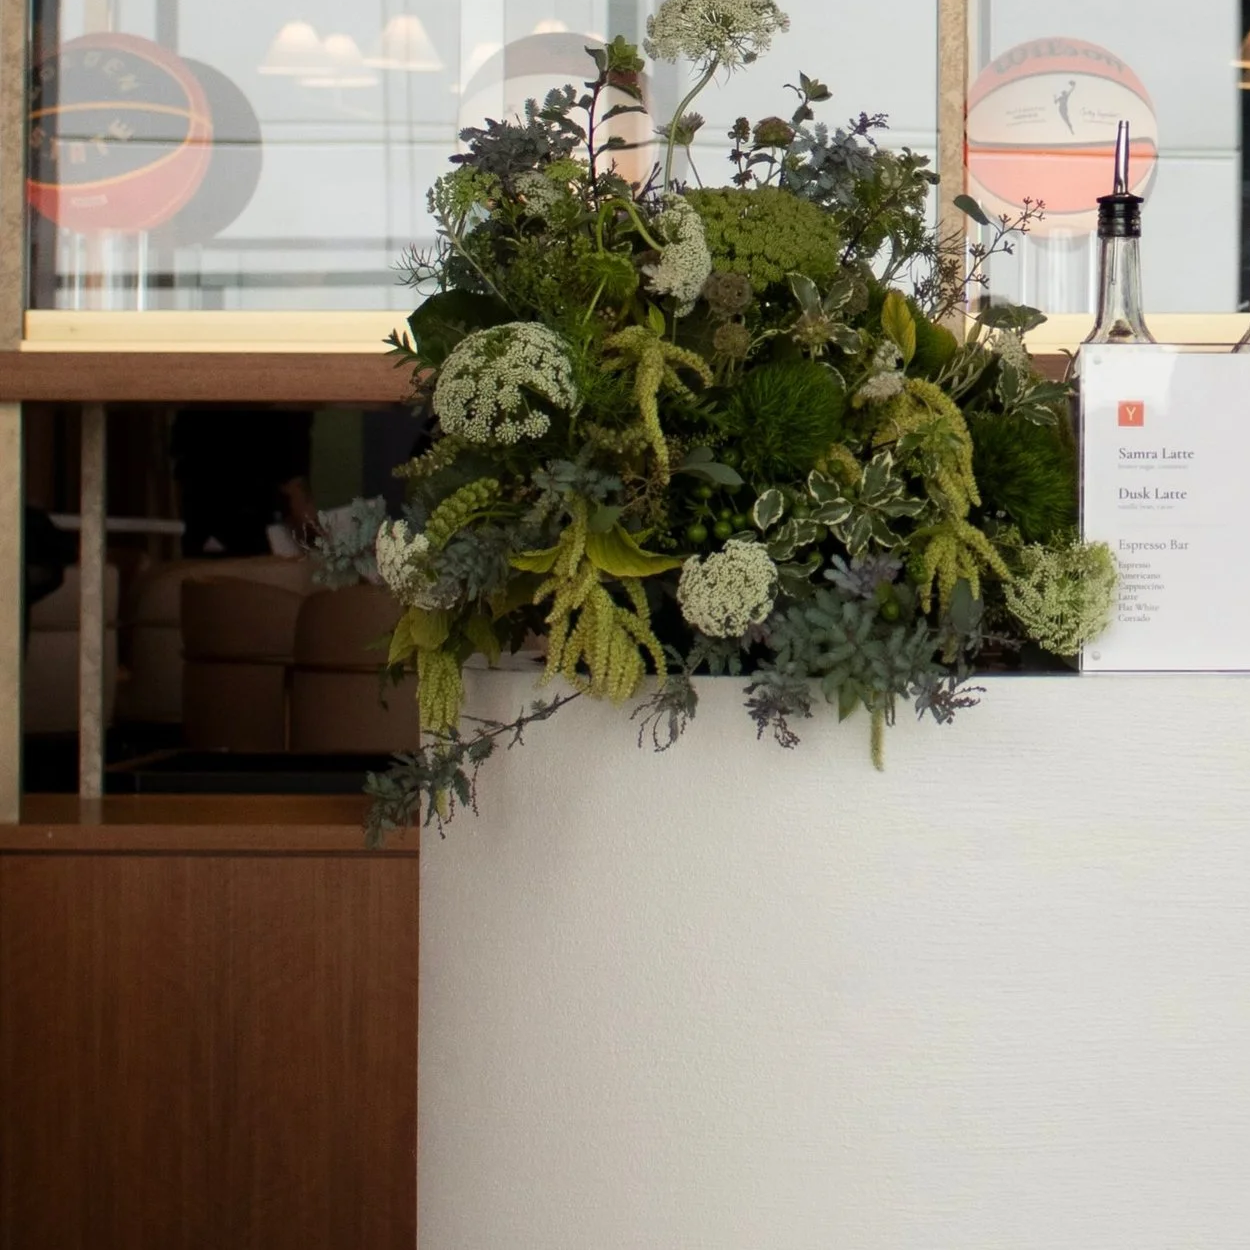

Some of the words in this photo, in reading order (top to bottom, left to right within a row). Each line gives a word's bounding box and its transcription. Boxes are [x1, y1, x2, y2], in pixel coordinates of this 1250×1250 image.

[1118, 447, 1158, 460] Samra
[1162, 447, 1195, 460] Latte
[1118, 486, 1151, 500] Dusk
[1154, 488, 1188, 500] Latte
[1118, 539, 1167, 554] Espresso
[1169, 539, 1190, 551] Bar
